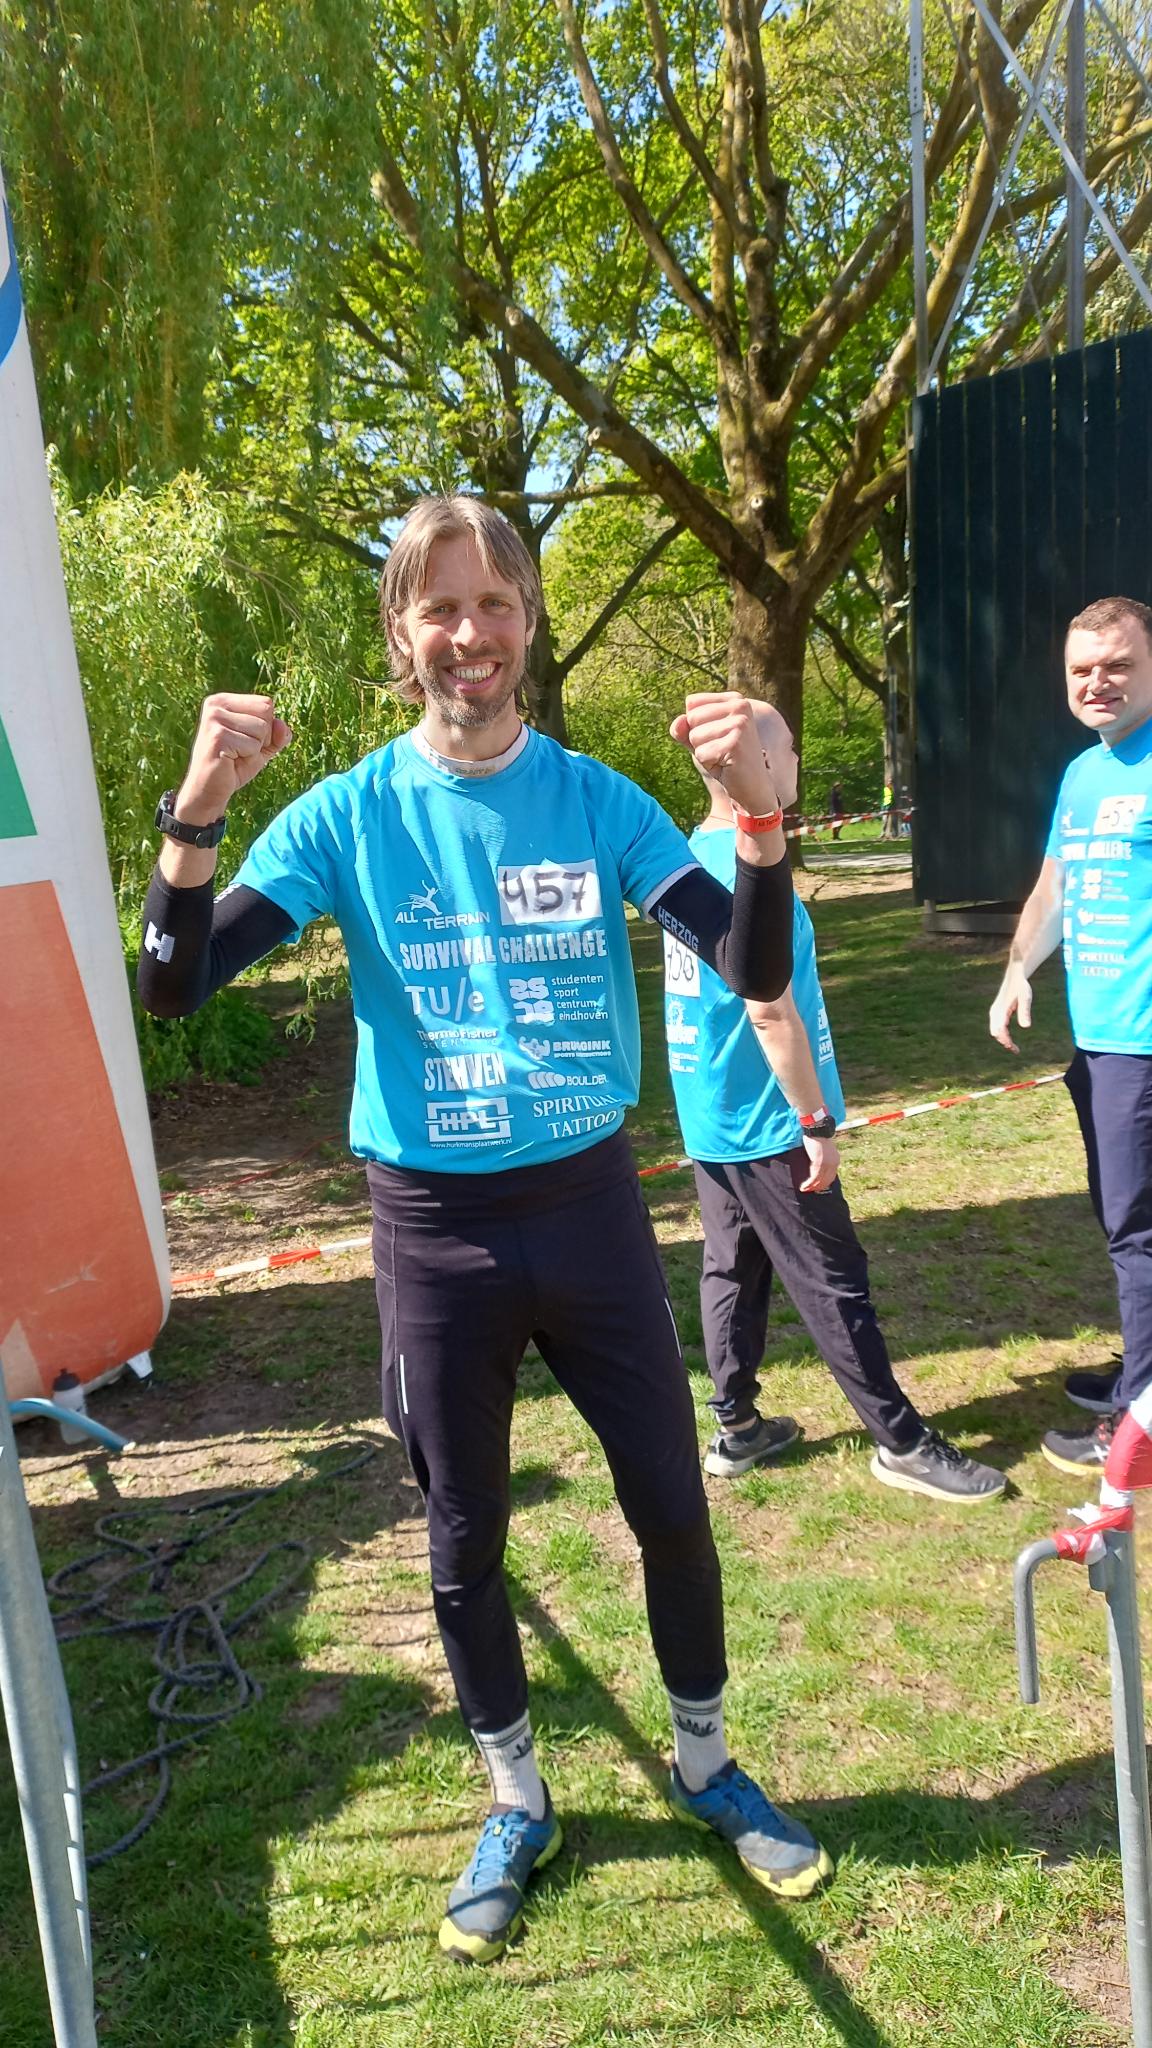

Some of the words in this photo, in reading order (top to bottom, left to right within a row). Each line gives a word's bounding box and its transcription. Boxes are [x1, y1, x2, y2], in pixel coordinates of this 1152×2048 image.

[503, 869, 588, 915] 457
[395, 911, 418, 924] ALL
[423, 911, 491, 931] TERRAIN
[657, 905, 699, 952] HERZOG
[400, 935, 497, 971] SURVIVAL
[499, 929, 608, 964] CHALLENGE
[551, 974, 604, 985] studenten
[404, 977, 485, 1022] TU/e
[554, 987, 579, 999] sport
[556, 999, 597, 1010] centrum
[559, 1010, 609, 1021] eindhoven
[566, 1074, 608, 1087] BOULDER
[533, 1093, 622, 1118] SPIRITUAL
[547, 1110, 618, 1139] TATTOO
